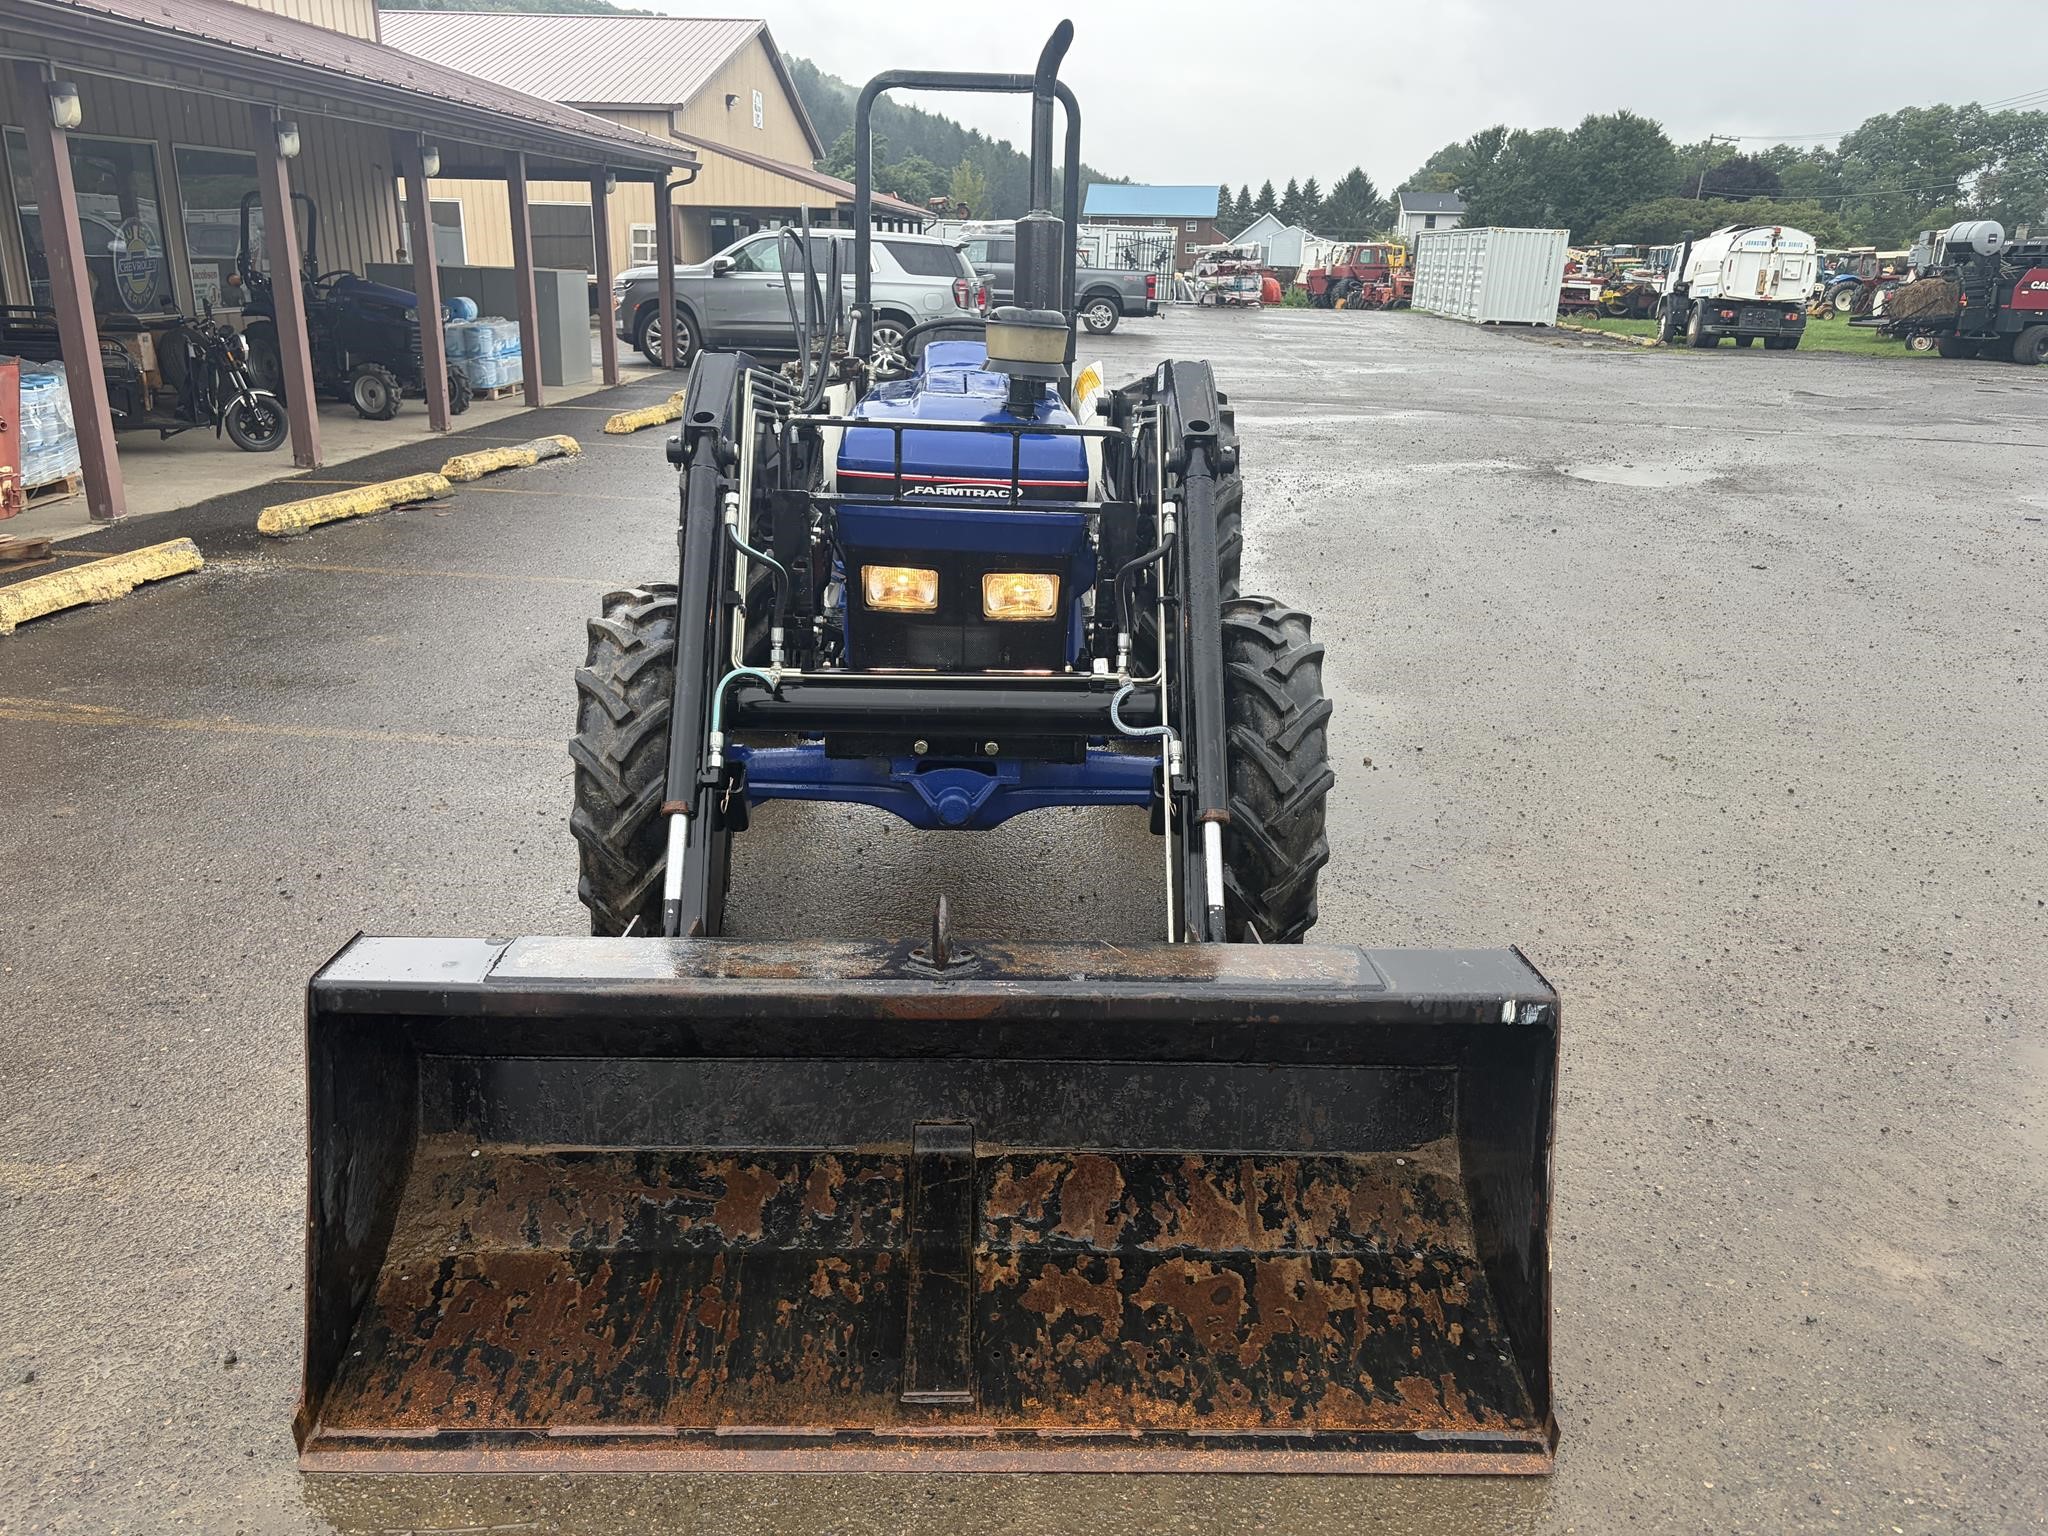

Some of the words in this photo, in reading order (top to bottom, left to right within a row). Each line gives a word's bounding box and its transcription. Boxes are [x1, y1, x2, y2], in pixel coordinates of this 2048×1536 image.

[119, 260, 157, 273] CHEVROLET
[2031, 281, 2048, 290] CA
[914, 486, 1010, 498] FARMTRAC
